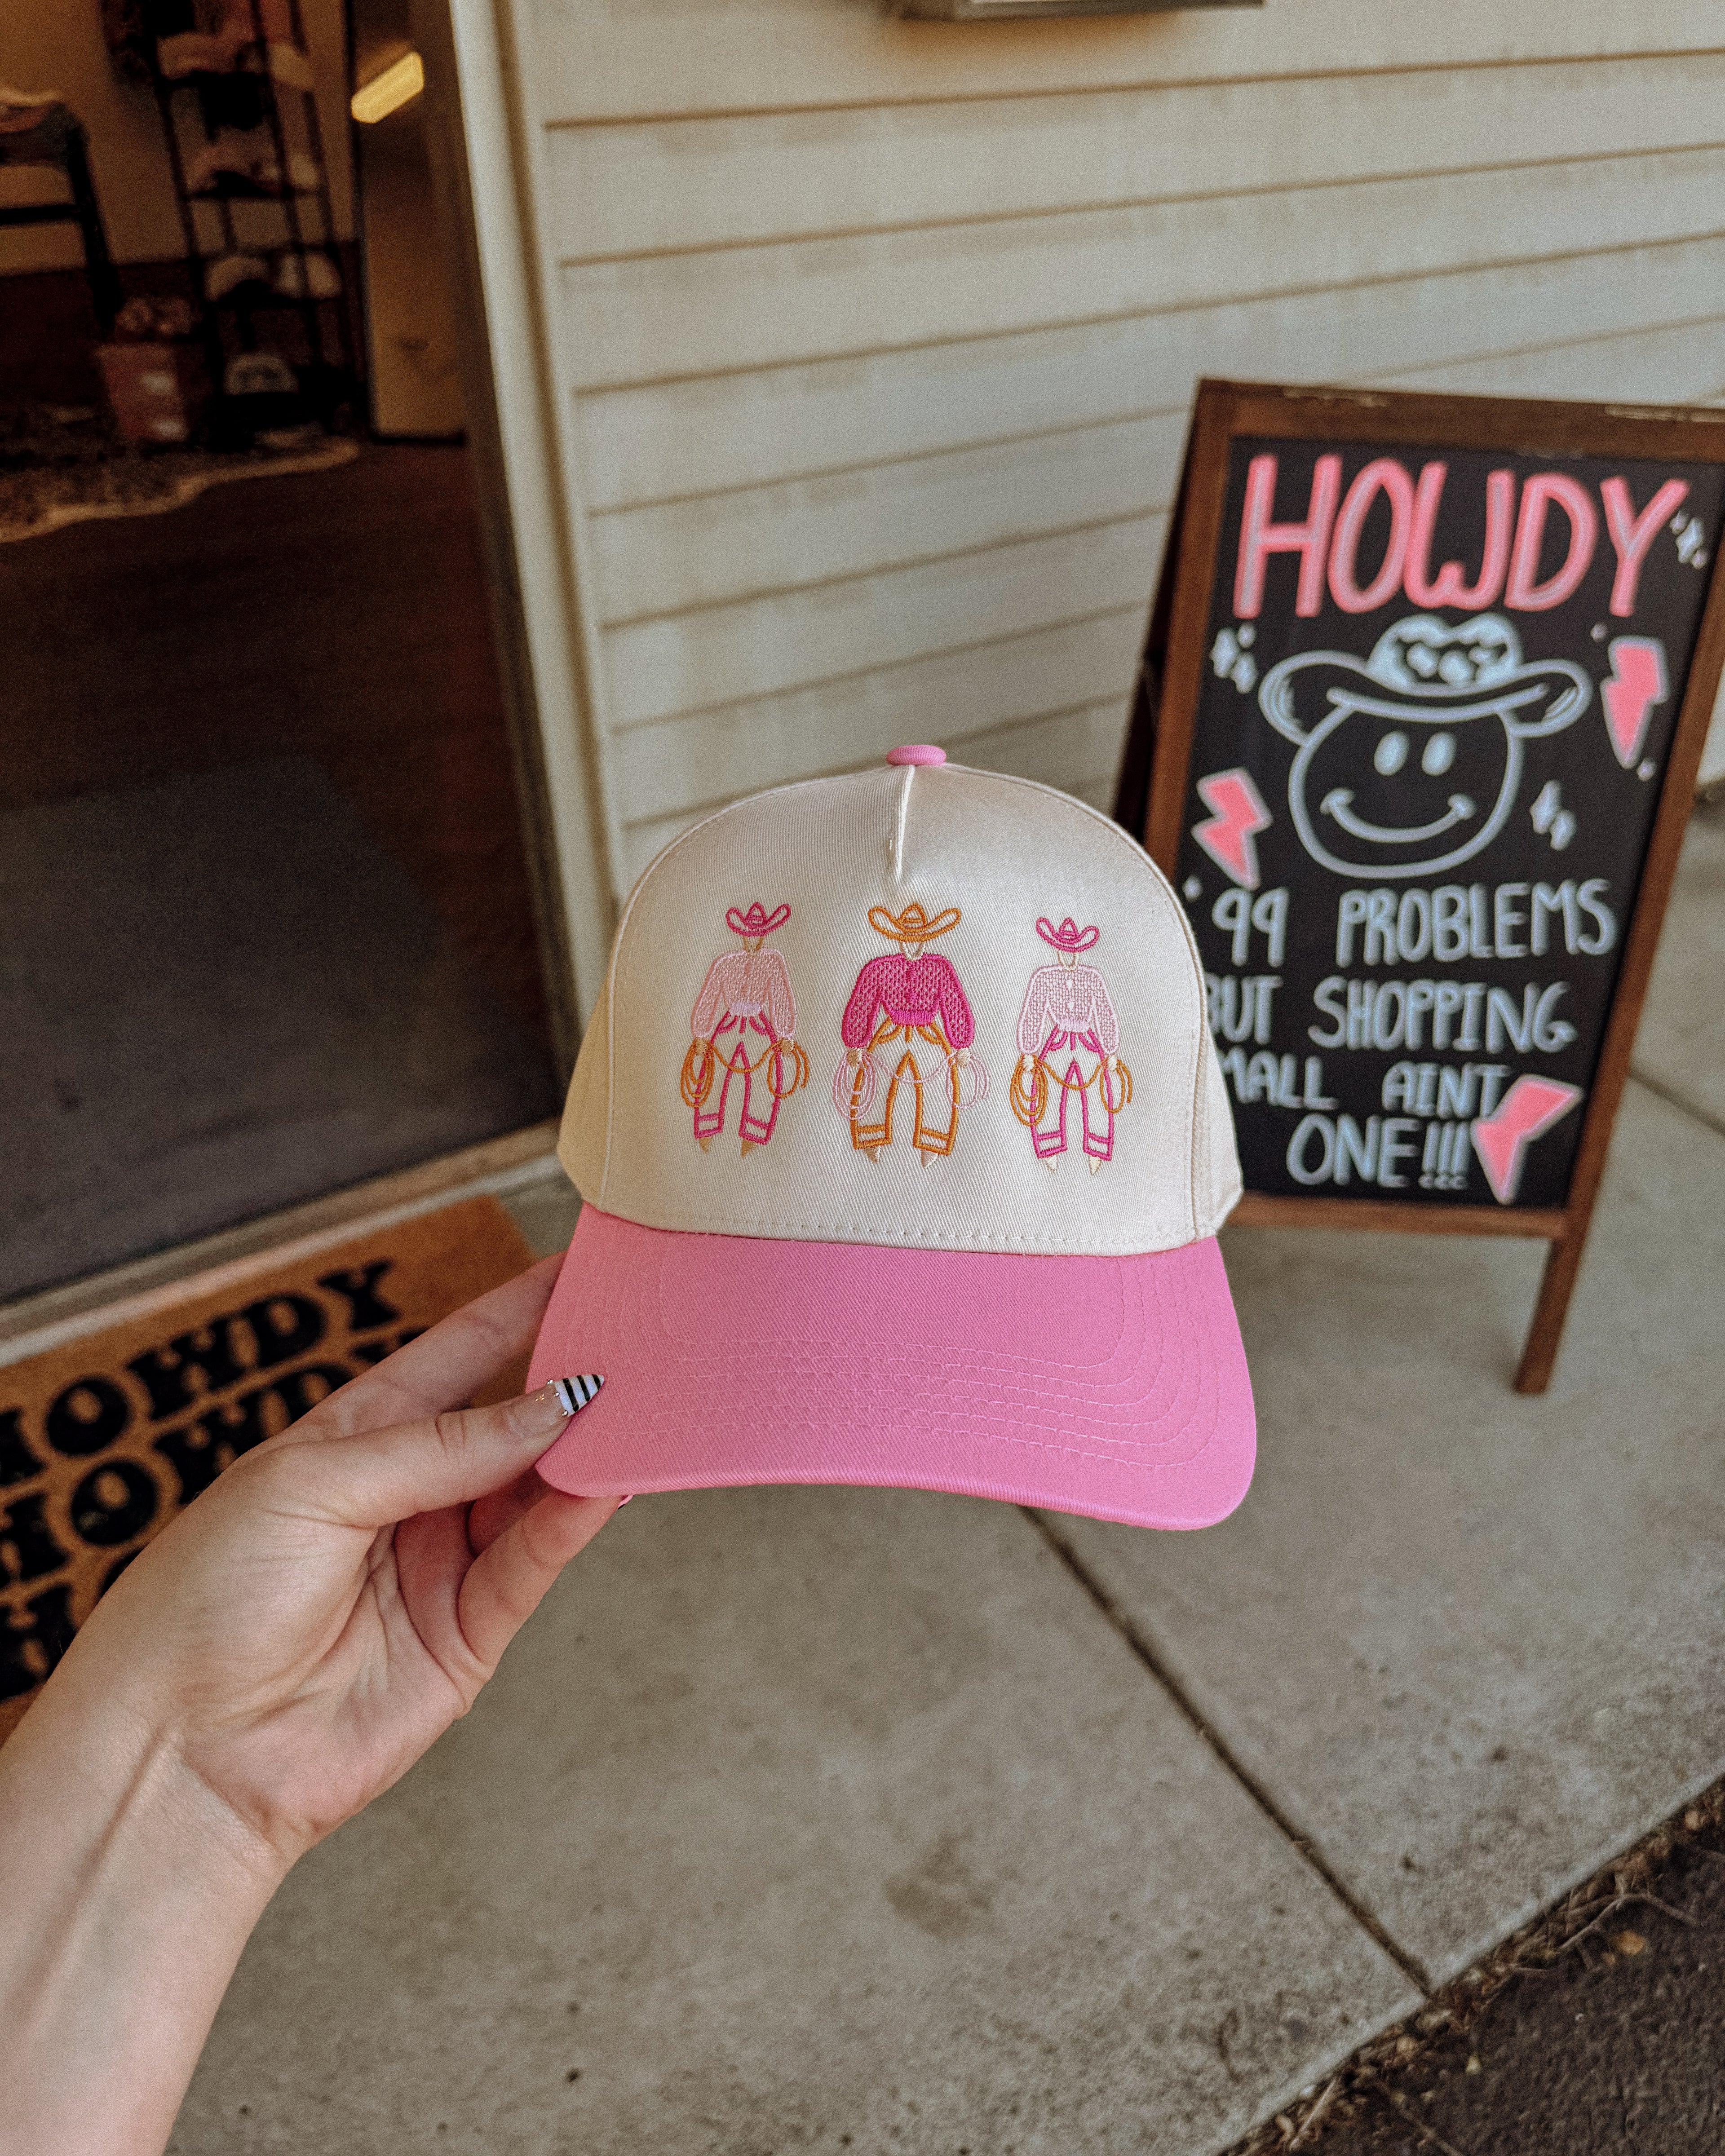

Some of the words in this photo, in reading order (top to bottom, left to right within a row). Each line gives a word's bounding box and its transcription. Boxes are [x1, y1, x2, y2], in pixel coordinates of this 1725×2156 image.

[1233, 454, 1691, 619] HOWDY
[1211, 888, 1289, 968] 99
[1336, 878, 1618, 968] PROBLEMS
[1308, 975, 1578, 1055] SHOPPING
[1382, 1059, 1512, 1119] AINT
[1286, 1114, 1472, 1190] ONE!!!
